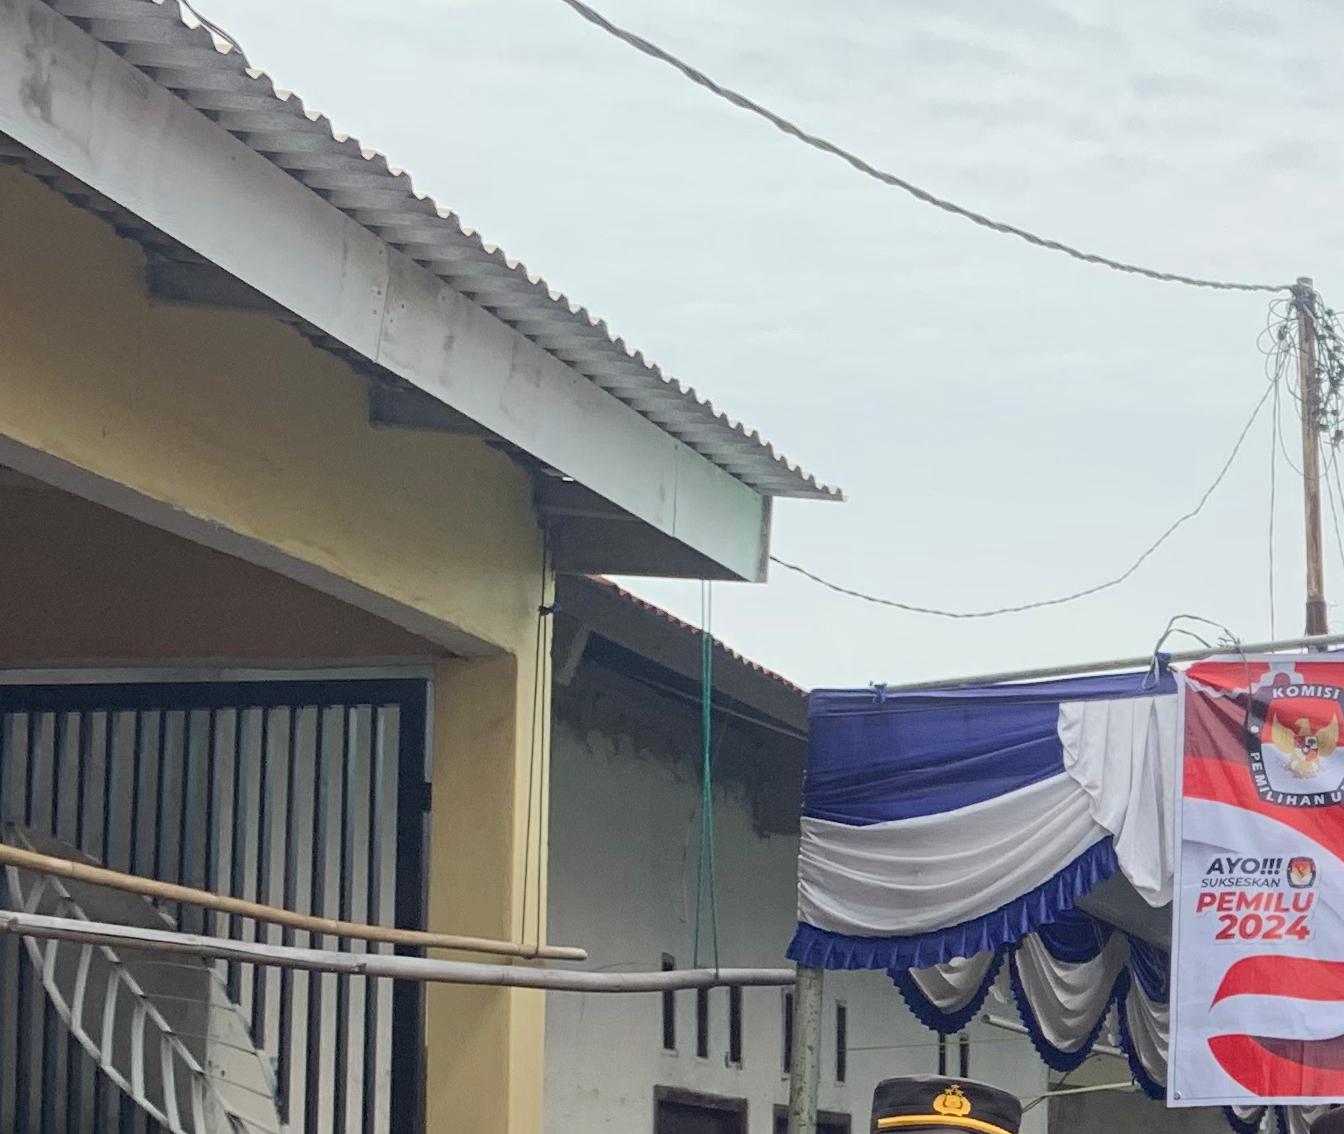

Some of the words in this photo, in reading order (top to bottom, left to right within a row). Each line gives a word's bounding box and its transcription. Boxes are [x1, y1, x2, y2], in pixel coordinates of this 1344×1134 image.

[1272, 685, 1341, 700] KOMISI
[1250, 752, 1326, 806] PEMILIHAN
[1206, 857, 1283, 876] AYO!!!
[1200, 877, 1281, 888] SUKSESKAN
[1196, 891, 1315, 914] PEMILU
[1214, 913, 1311, 941] 2024
